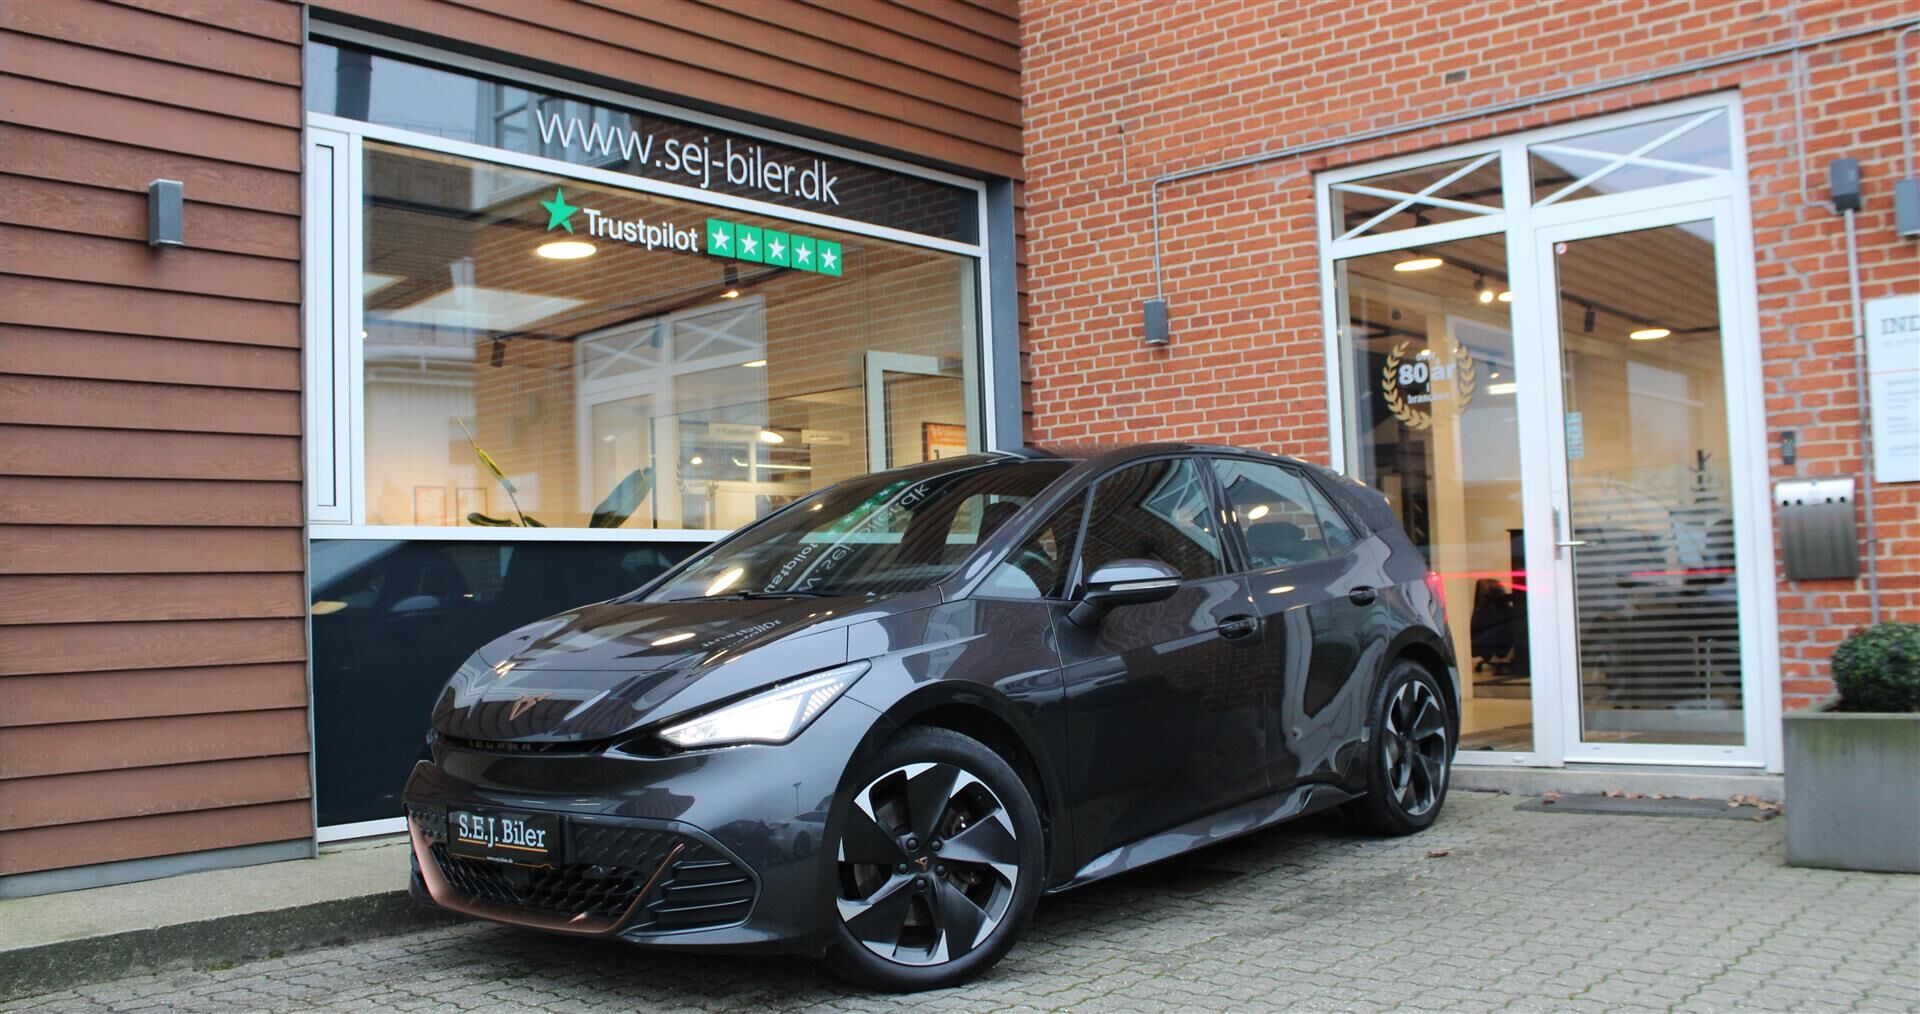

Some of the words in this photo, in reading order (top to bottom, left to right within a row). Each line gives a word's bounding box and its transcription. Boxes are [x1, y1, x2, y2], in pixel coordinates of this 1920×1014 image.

[536, 109, 840, 205] www.sej-biler.dk
[583, 207, 699, 252] Trustpilot
[1398, 362, 1428, 385] 80
[1431, 358, 1457, 380] år
[458, 814, 499, 848] S.E.J.
[502, 818, 546, 848] Biler
